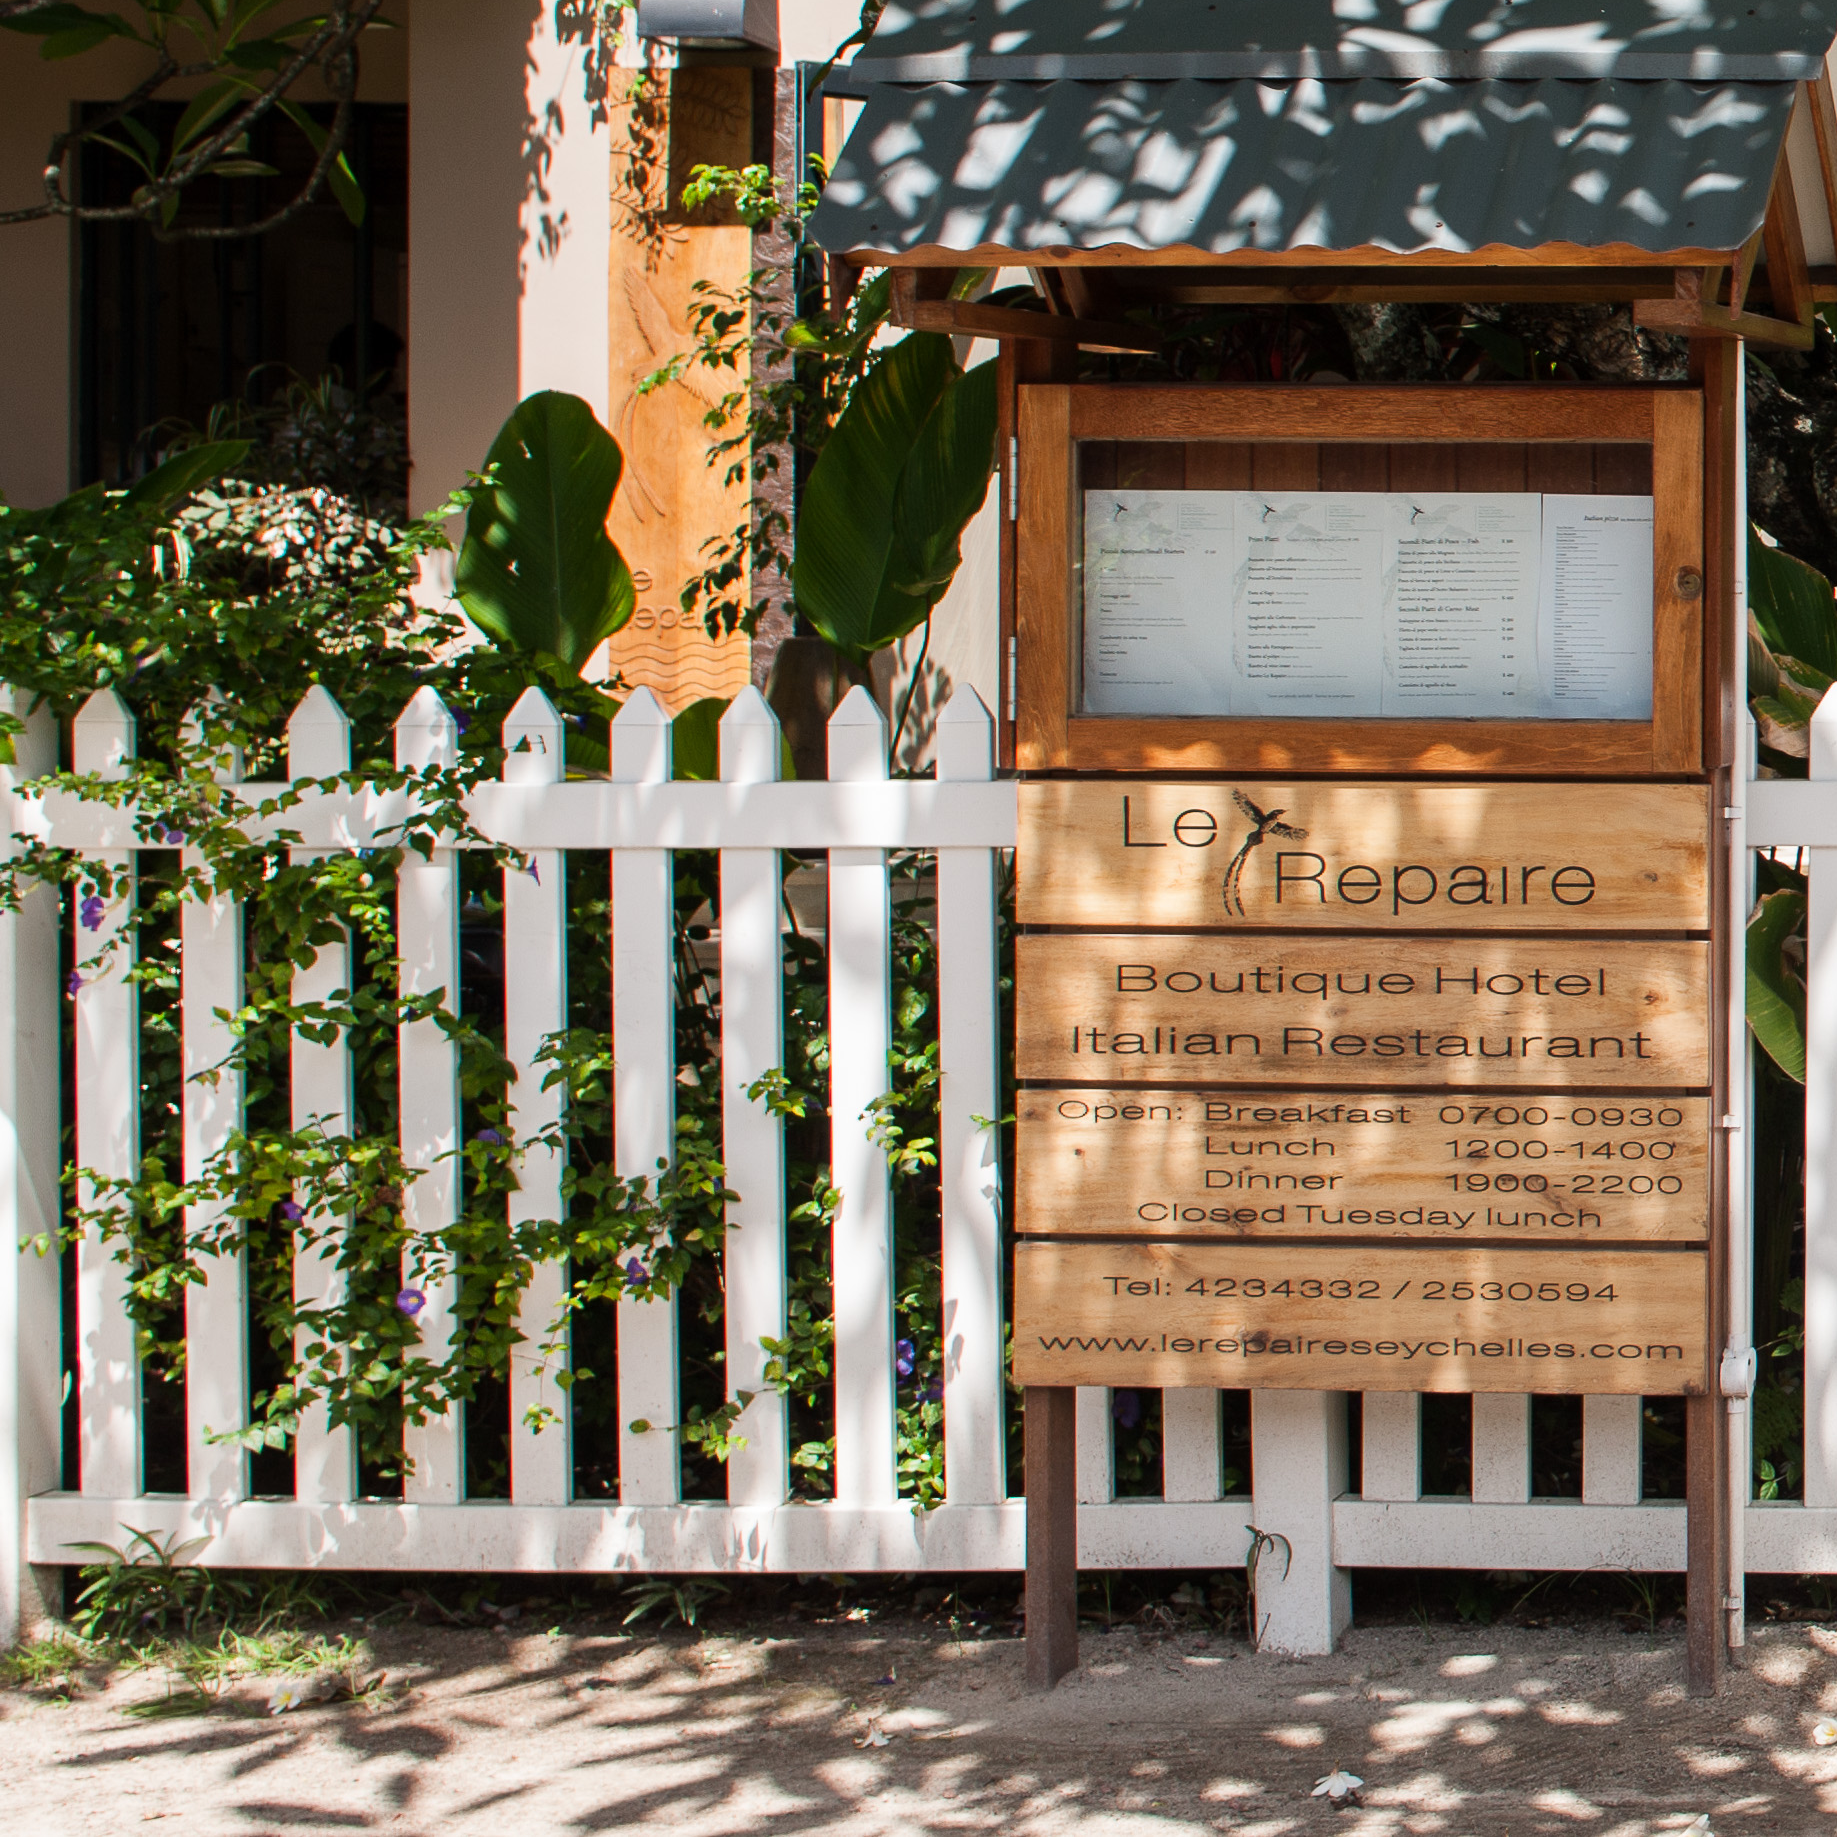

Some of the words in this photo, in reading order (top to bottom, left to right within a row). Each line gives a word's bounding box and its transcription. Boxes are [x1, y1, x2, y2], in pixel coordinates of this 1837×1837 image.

[1123, 795, 1218, 848] Le
[1273, 850, 1597, 917] Repaire
[1116, 964, 1416, 1001] Boutique
[1433, 966, 1606, 997] Hotel
[1071, 1026, 1261, 1057] Italian
[1281, 1027, 1653, 1060] Restaurant
[1057, 1099, 1184, 1124] Open:
[1204, 1101, 1412, 1126] Breakfast
[1438, 1105, 1684, 1130] 0700-0930
[1203, 1135, 1335, 1157] Lunch
[1445, 1139, 1676, 1161] 1200-1400
[1205, 1169, 1345, 1191] Dinner
[1445, 1173, 1684, 1196] 1900-2200
[1137, 1202, 1286, 1225] Closed
[1297, 1205, 1476, 1231] Tuesday
[1487, 1205, 1602, 1228] lunch
[1102, 1276, 1172, 1297] Tel:
[1184, 1276, 1382, 1300] 4234332
[1421, 1280, 1620, 1303] 2530594
[1037, 1330, 1684, 1360] www.lerepaireseychelles.com
